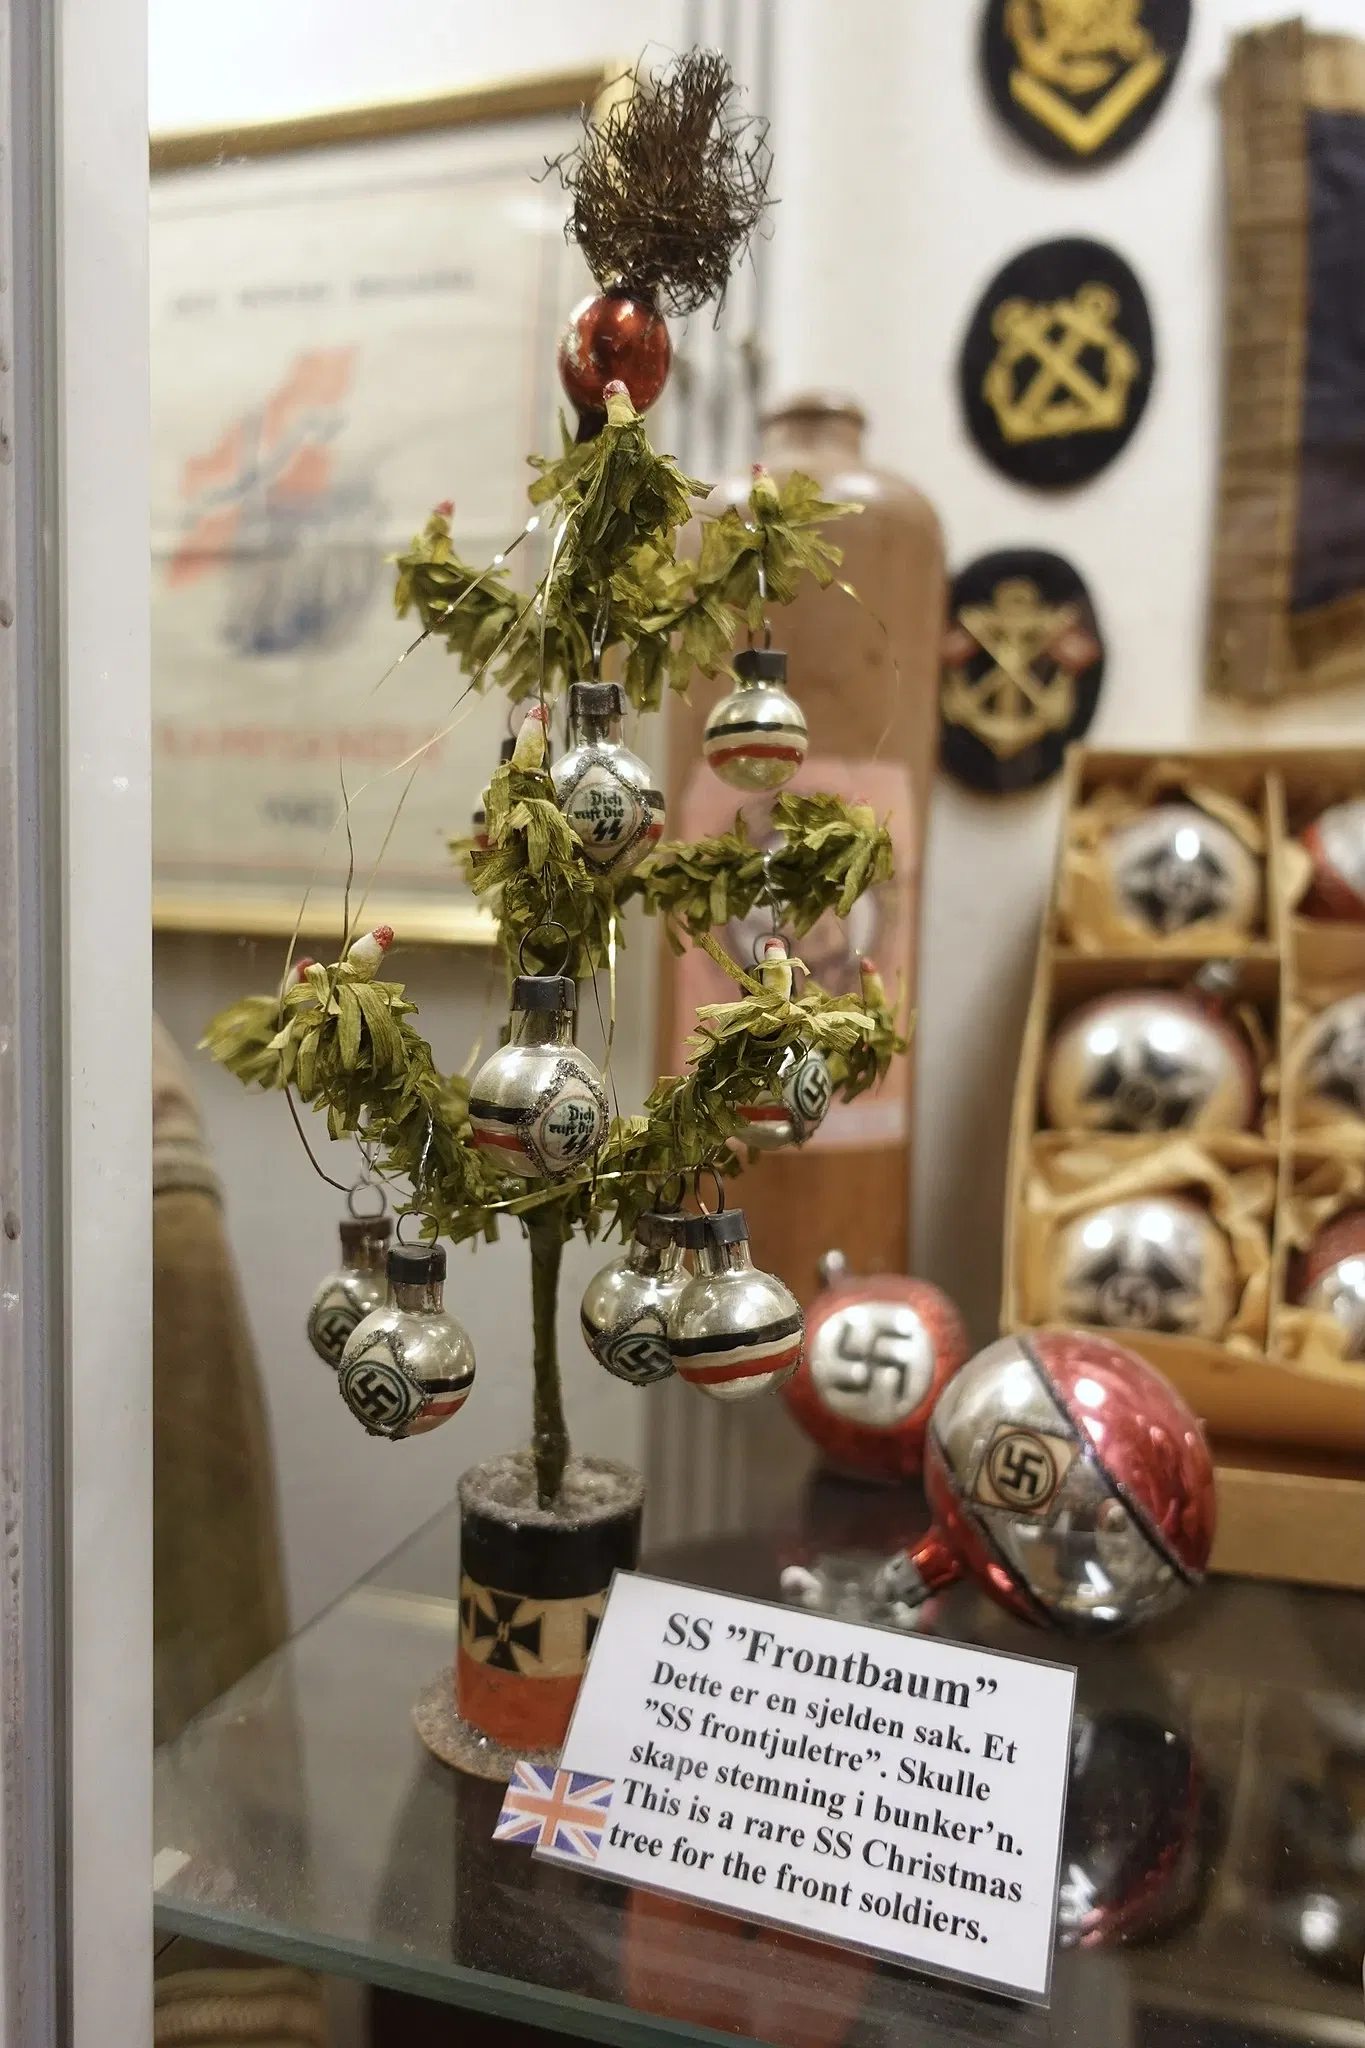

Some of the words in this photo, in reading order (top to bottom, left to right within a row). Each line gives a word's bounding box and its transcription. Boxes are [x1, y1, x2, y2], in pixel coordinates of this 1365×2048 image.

[662, 1612, 713, 1651] SS
[651, 1659, 722, 1698] Dette
[730, 1684, 759, 1705] er
[766, 1692, 797, 1715] en
[805, 1698, 904, 1739] sjelden
[913, 1724, 971, 1754] sak.
[980, 1731, 1018, 1764] Et
[629, 1740, 709, 1781] skape
[715, 1763, 847, 1820] stemning
[853, 1790, 865, 1817] i
[897, 1756, 991, 1801] Skulle
[608, 1821, 663, 1857] tree
[671, 1835, 714, 1870] for
[722, 1850, 766, 1885] the
[774, 1862, 853, 1907] front
[859, 1892, 988, 1943] soldiers.
[623, 1777, 681, 1816] This
[688, 1794, 711, 1824] is
[718, 1810, 734, 1830] a
[744, 1815, 805, 1847] rare
[813, 1825, 853, 1860] SS
[862, 1838, 1022, 1903] Christmas
